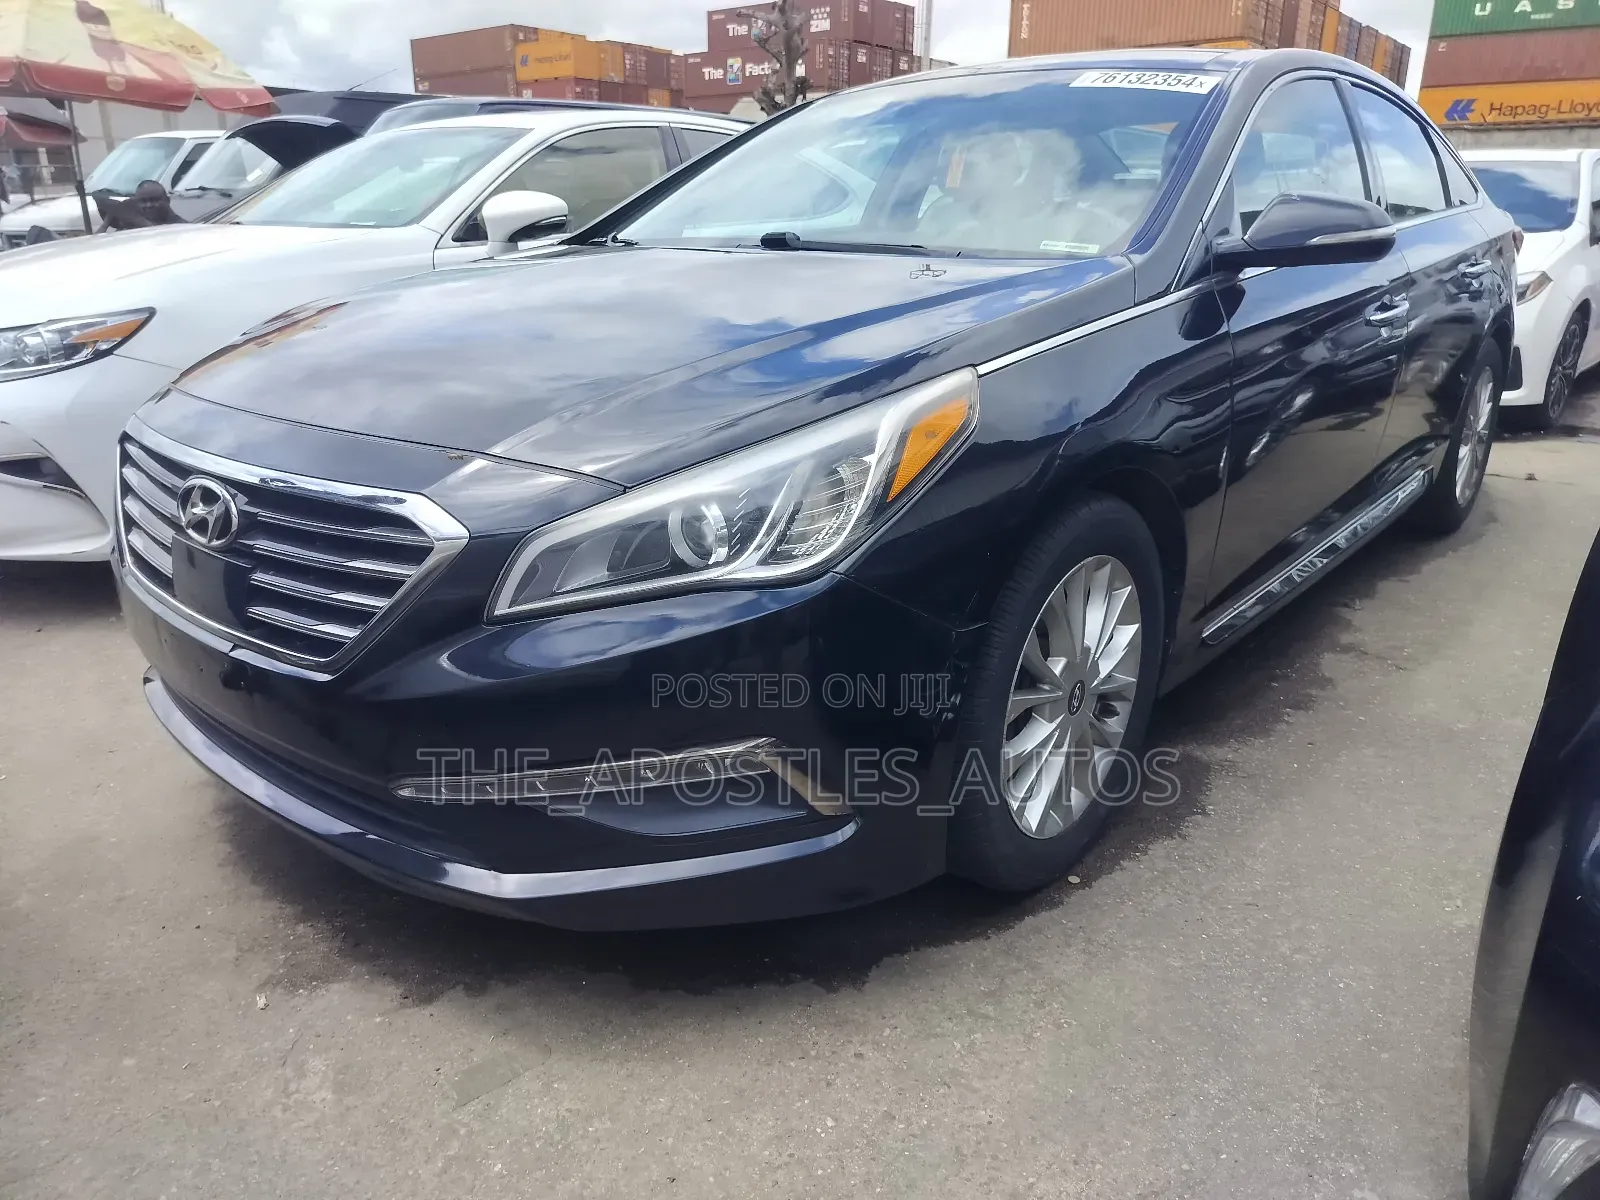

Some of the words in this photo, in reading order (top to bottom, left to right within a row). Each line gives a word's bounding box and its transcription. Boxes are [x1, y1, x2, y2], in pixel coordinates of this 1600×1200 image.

[1474, 0, 1600, 16] UAS
[726, 23, 749, 37] The
[810, 19, 831, 33] ZIM
[702, 67, 725, 81] The
